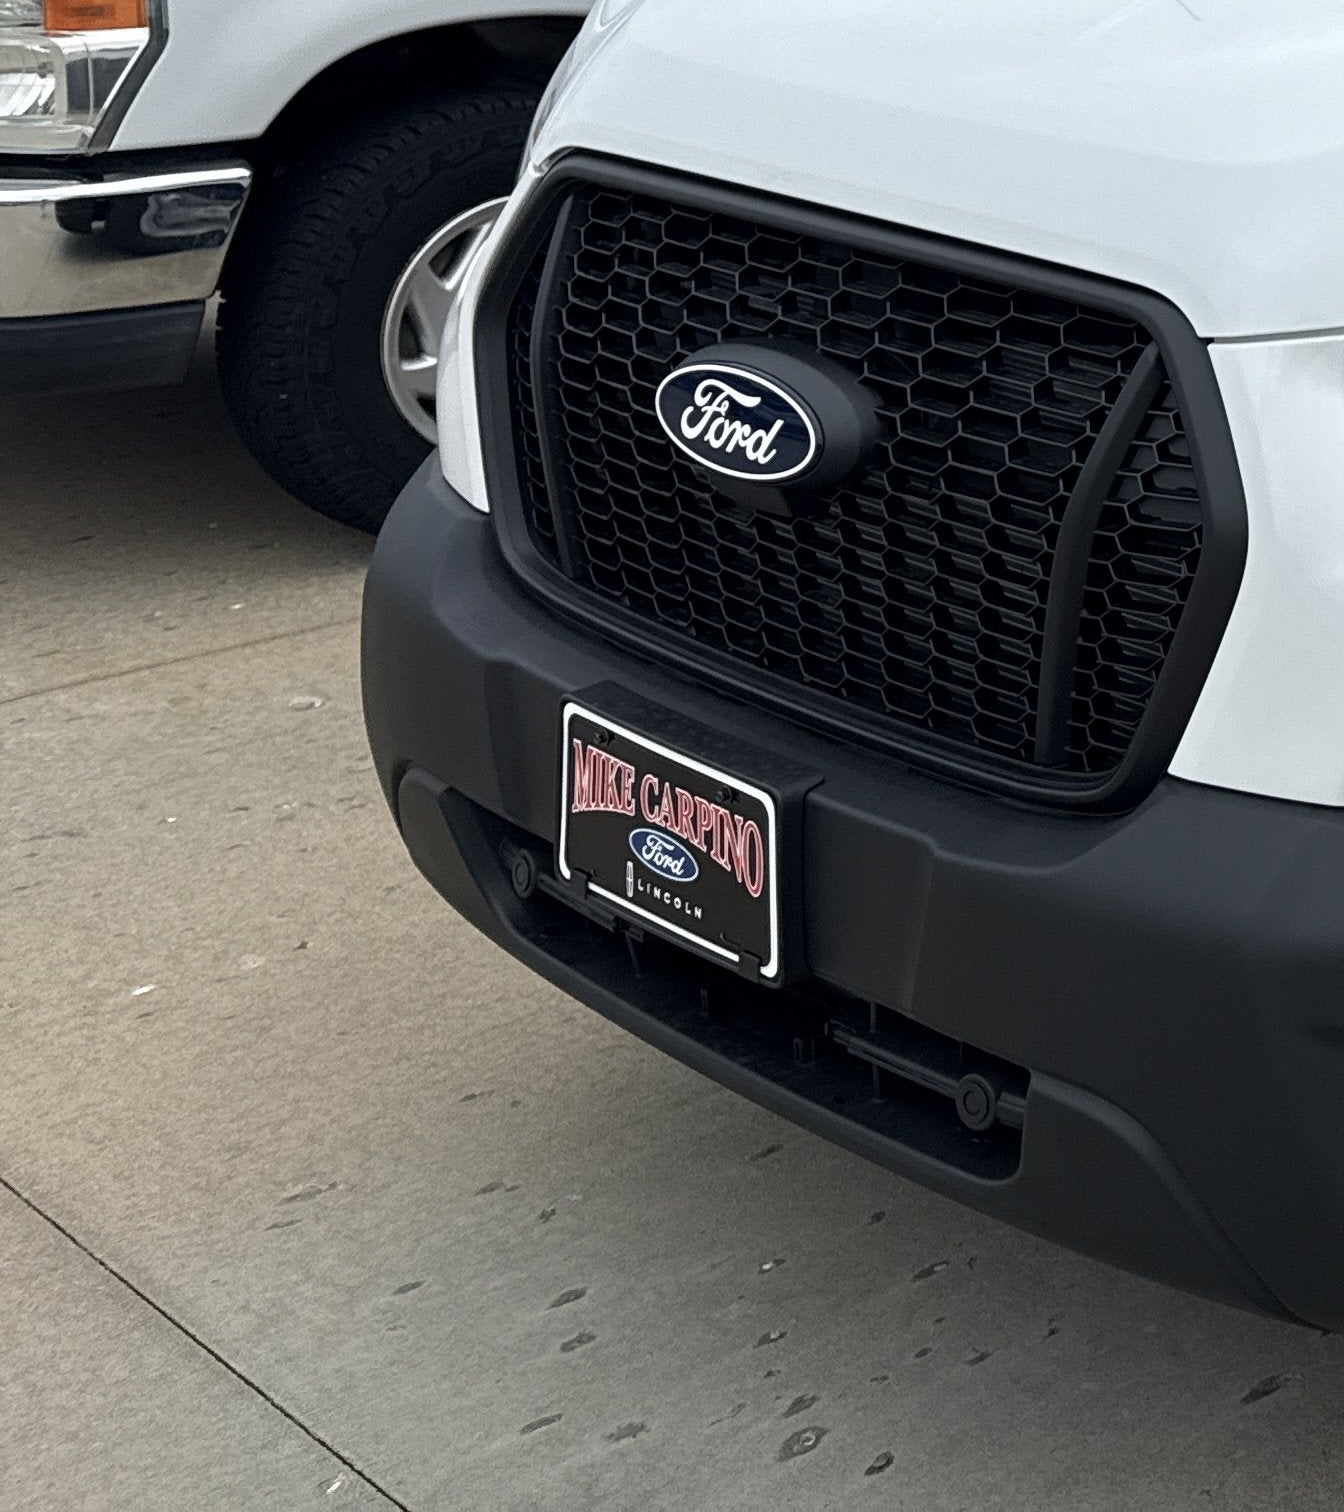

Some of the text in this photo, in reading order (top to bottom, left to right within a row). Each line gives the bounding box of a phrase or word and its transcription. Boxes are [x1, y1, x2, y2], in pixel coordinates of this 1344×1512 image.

[681, 378, 784, 465] Ford
[571, 738, 764, 898] MIKE CARPINO
[642, 834, 686, 877] Ford
[637, 878, 703, 920] LINCOLN
